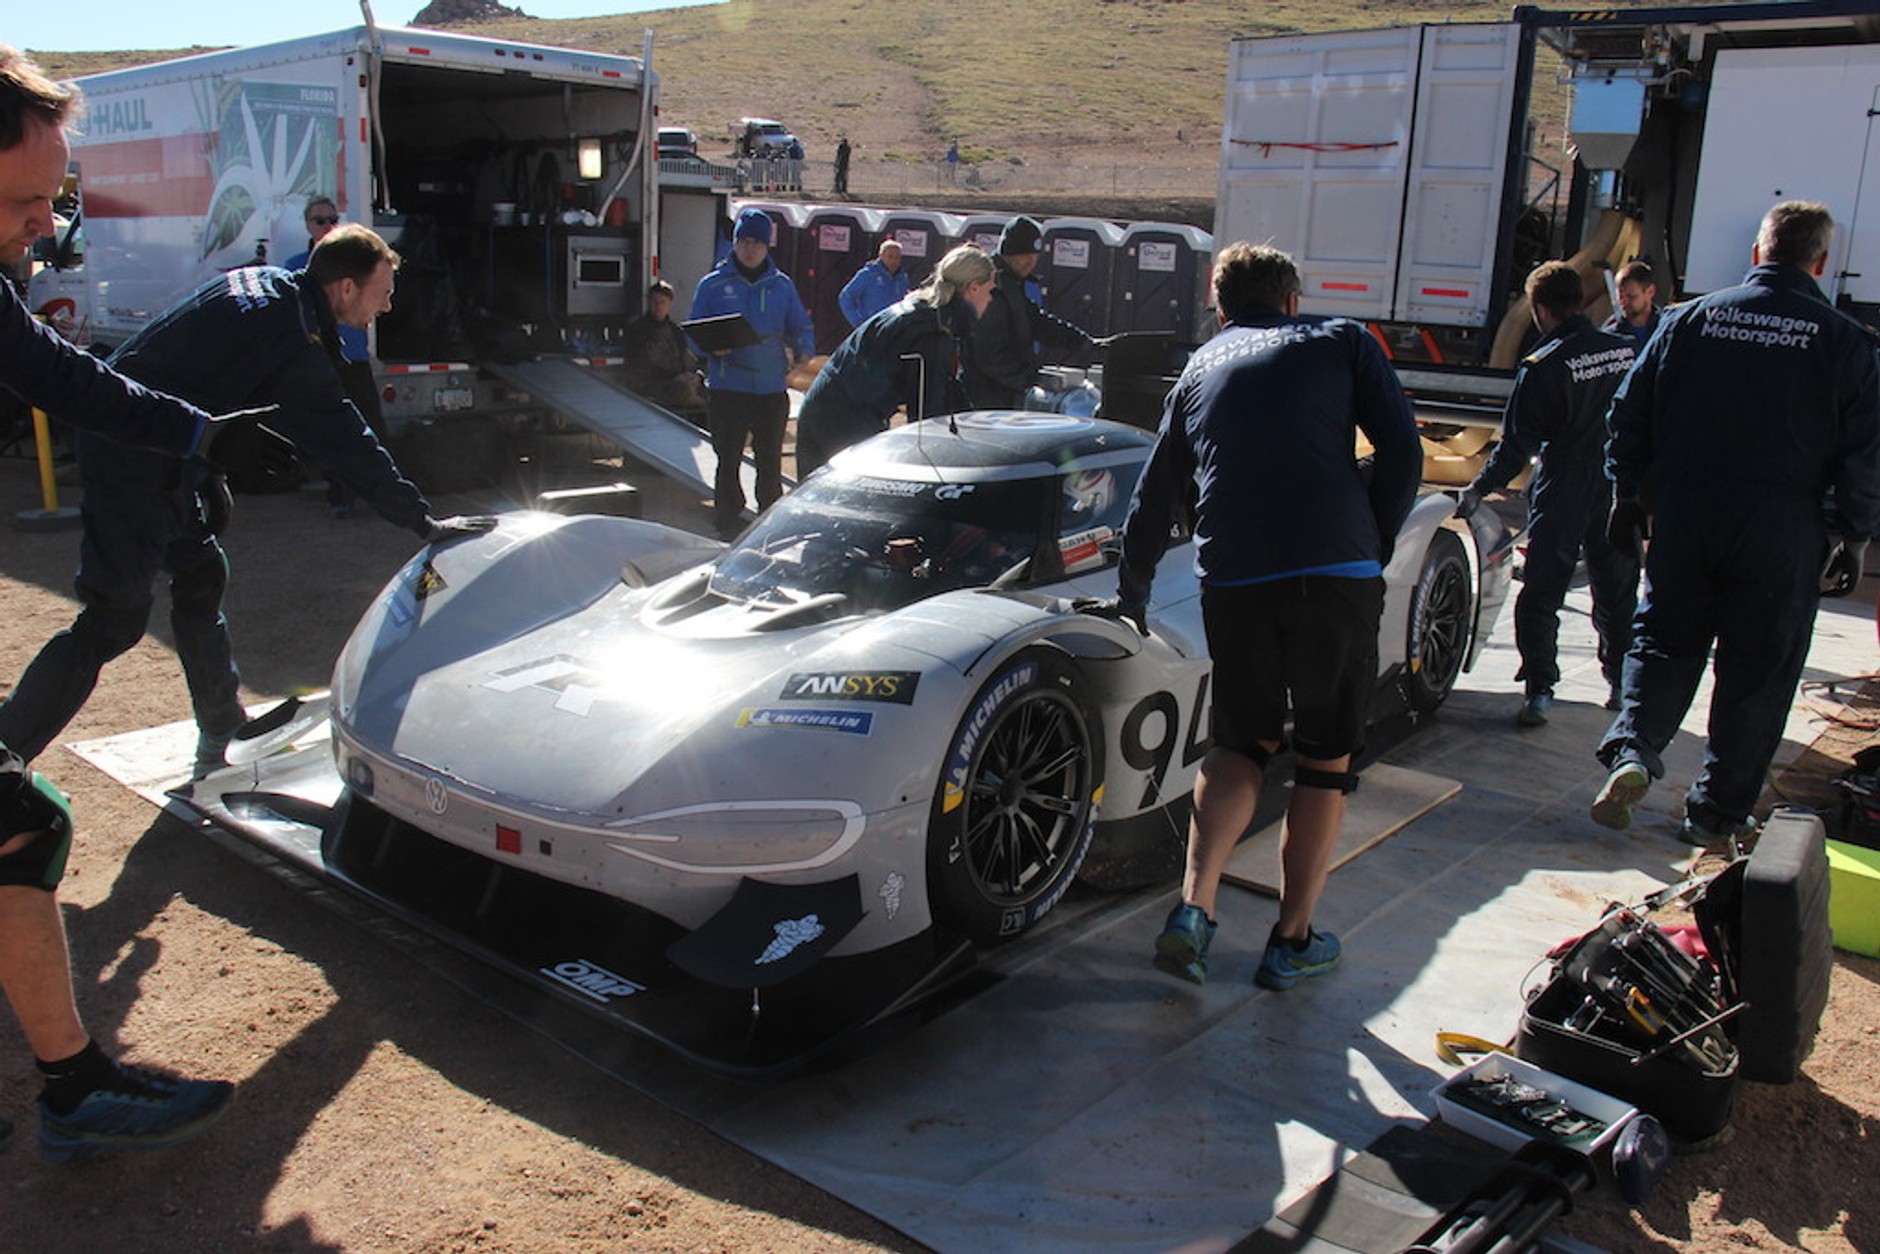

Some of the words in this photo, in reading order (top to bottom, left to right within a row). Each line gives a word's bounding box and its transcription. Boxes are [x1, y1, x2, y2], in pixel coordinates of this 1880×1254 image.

[1705, 306, 1819, 334] Volkswagen
[1701, 322, 1811, 349] Motorsport
[795, 674, 901, 697] ANSYS
[774, 713, 861, 728] MICHELIN
[959, 666, 1033, 762] MICHELIN
[554, 962, 636, 997] OMP
